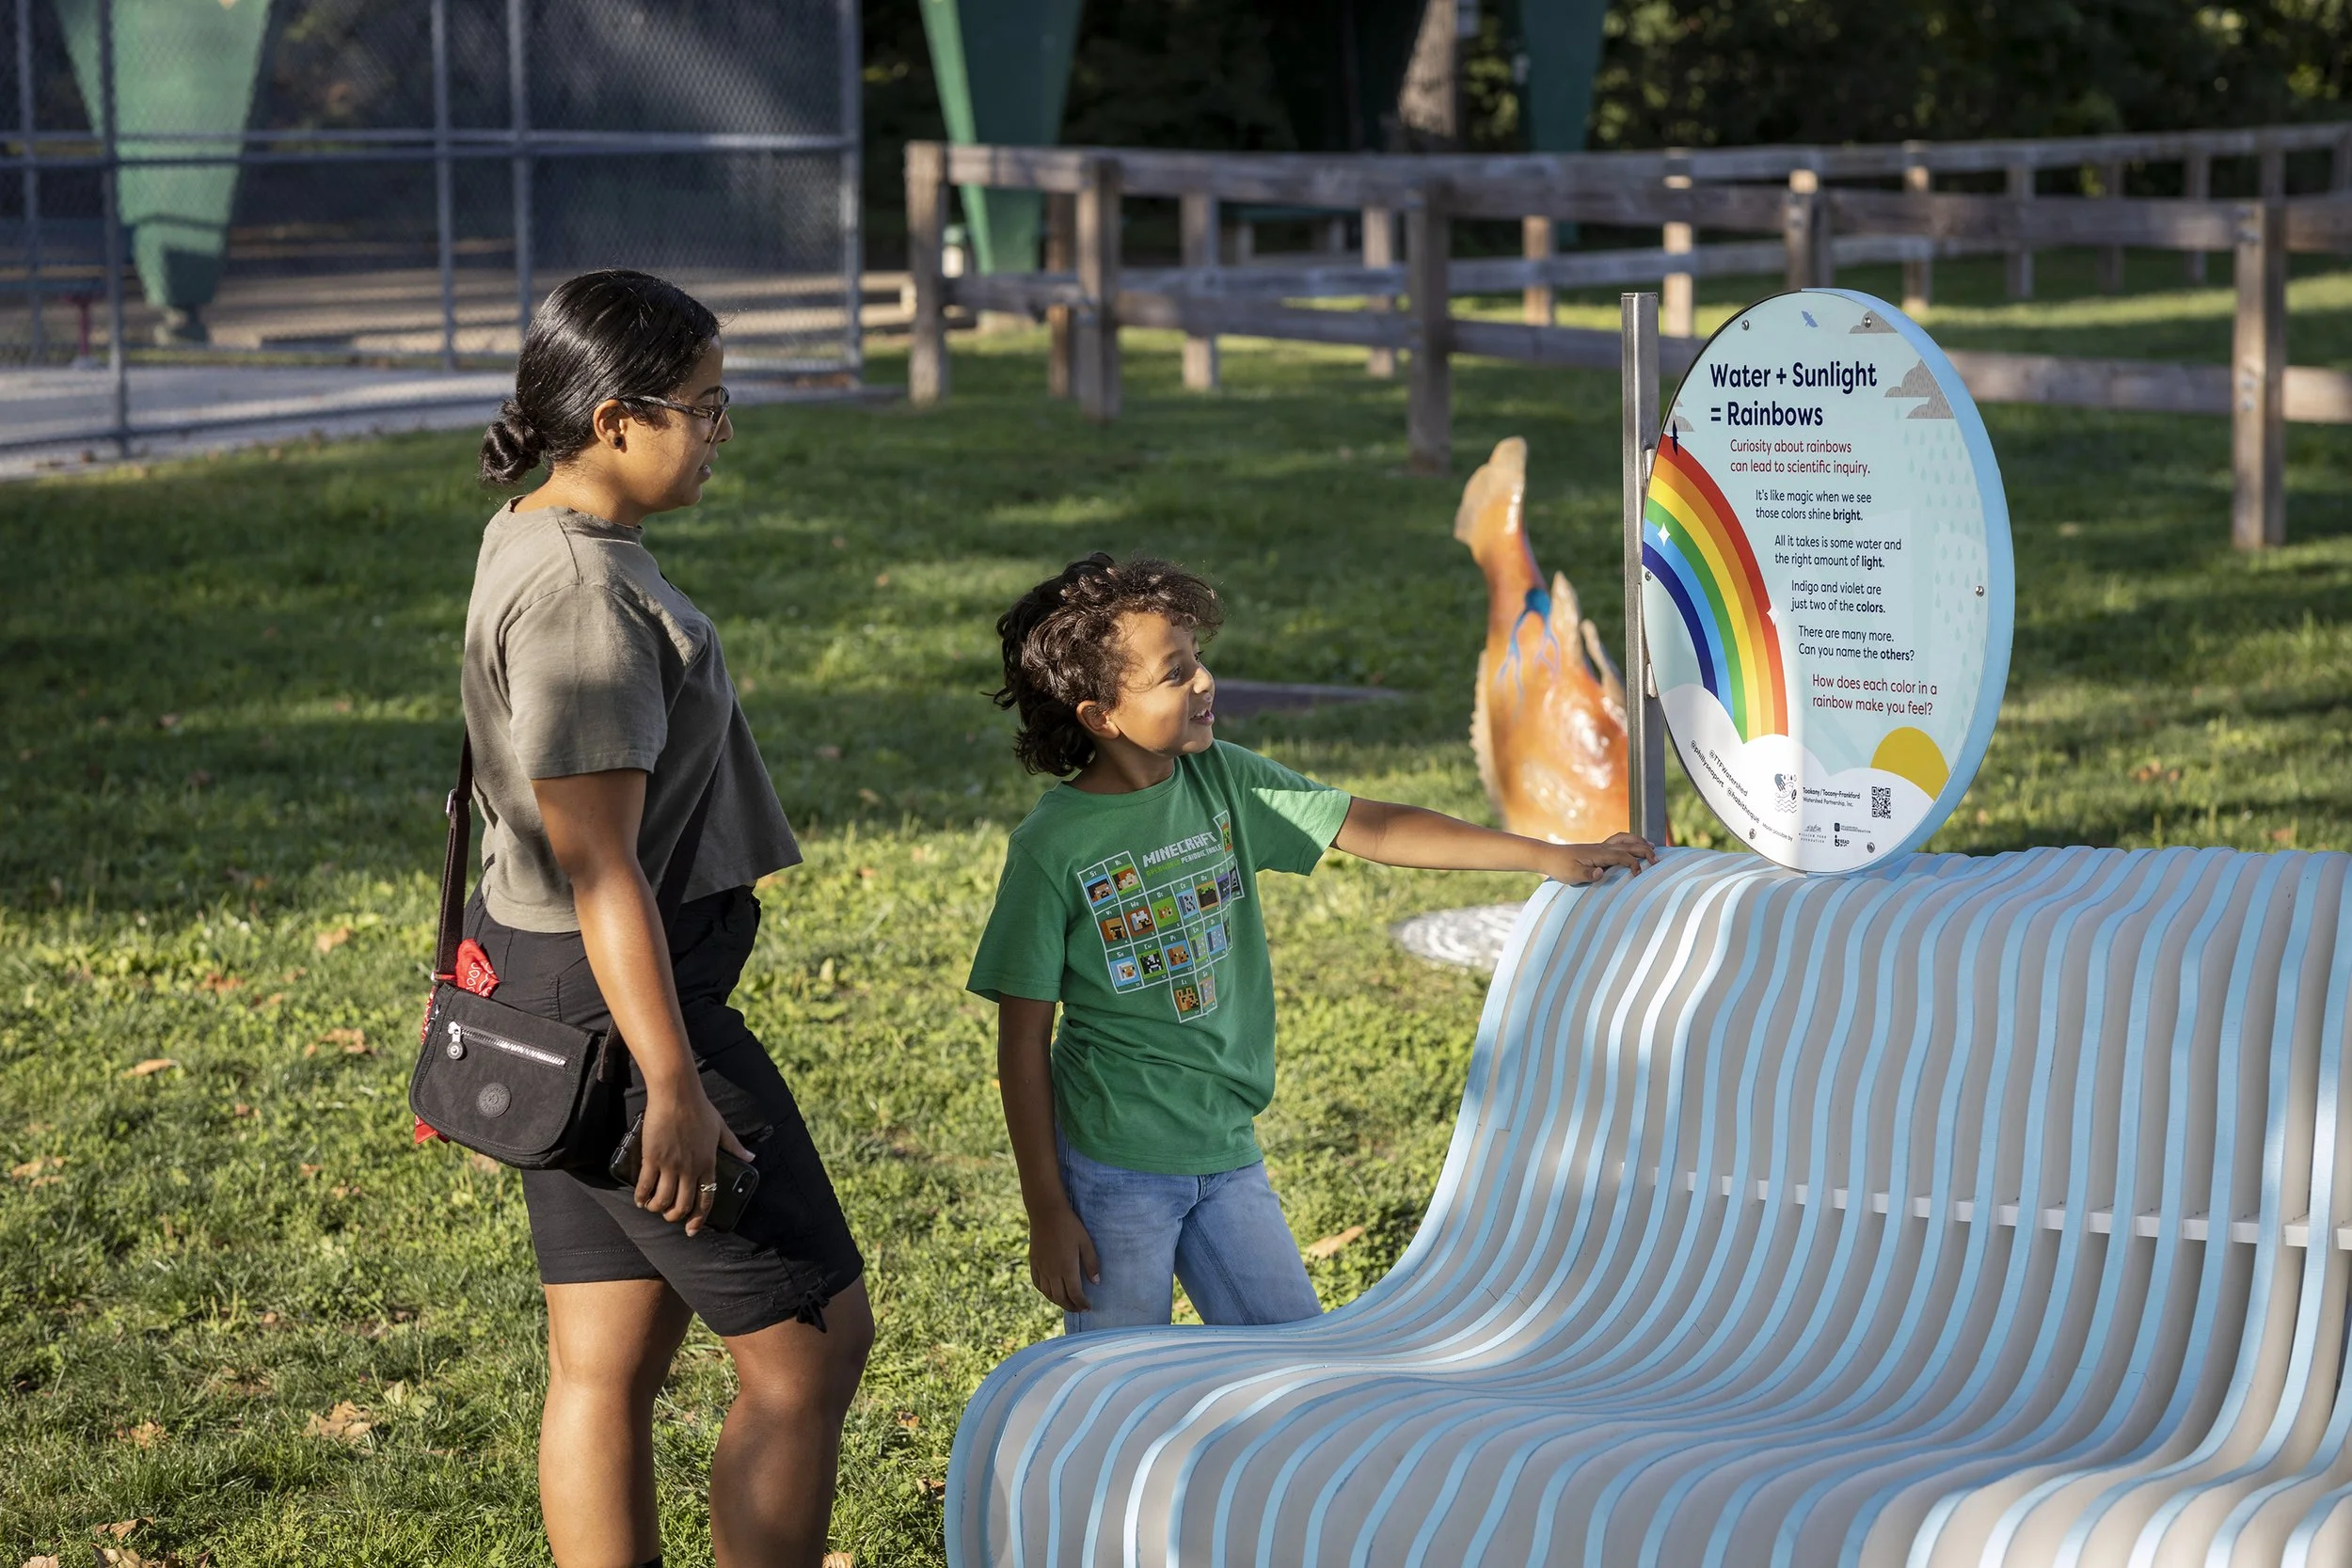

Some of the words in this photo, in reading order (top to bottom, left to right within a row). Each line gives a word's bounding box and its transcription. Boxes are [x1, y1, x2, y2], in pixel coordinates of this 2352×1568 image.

[1709, 363, 1772, 388] Water
[1776, 368, 1787, 385] +
[1792, 361, 1877, 394] Sunlight
[1710, 407, 1722, 421] =
[1727, 401, 1823, 426] Rainbows
[1730, 439, 1772, 455] Curiosity
[1774, 439, 1804, 452] about
[1806, 440, 1852, 453] rainbows
[1730, 462, 1748, 472] can
[1751, 460, 1772, 472] lead
[1774, 461, 1785, 473] to
[1788, 460, 1831, 473] scientific
[1834, 460, 1871, 477] inquiry.
[1770, 490, 1785, 501] like
[1787, 490, 1814, 505] magic
[1816, 491, 1839, 502] when
[1841, 494, 1854, 503] we
[1856, 494, 1872, 503] see
[1756, 507, 1779, 519] those
[1781, 508, 1806, 519] colors
[1808, 508, 1831, 520] shine
[1833, 509, 1864, 524] bright.
[1774, 535, 1786, 546] All
[1788, 535, 1794, 547] it
[1796, 536, 1820, 547] takes
[1821, 536, 1829, 548] is
[1830, 539, 1853, 548] some
[1855, 540, 1882, 550] water
[1883, 539, 1902, 550] and
[1774, 552, 1789, 564] the
[1791, 553, 1812, 568] right
[1814, 556, 1849, 566] amount
[1850, 555, 1861, 567] of
[1861, 556, 1885, 571] light.
[1791, 579, 1819, 595] Indigo
[1820, 581, 1838, 594] and
[1840, 581, 1866, 594] violet
[1867, 585, 1882, 595] are
[1790, 597, 1807, 612] just
[1809, 598, 1826, 610] two
[1828, 599, 1838, 611] of
[1839, 599, 1854, 611] the
[1856, 600, 1886, 613] colors.
[1798, 626, 1823, 638] There
[1825, 628, 1840, 639] are
[1842, 629, 1867, 643] many
[1868, 631, 1895, 642] more.
[1798, 642, 1816, 655] Can
[1818, 646, 1834, 658] you
[1836, 647, 1861, 658] name
[1863, 647, 1879, 659] the
[1881, 648, 1915, 661] others?
[1812, 673, 1835, 688] How
[1836, 675, 1861, 689] does
[1863, 678, 1888, 691] each
[1890, 679, 1916, 693] color
[1918, 680, 1928, 695] in
[1930, 685, 1938, 695] a
[1812, 694, 1853, 709] rainbow
[1855, 699, 1884, 712] make
[1886, 702, 1905, 716] you
[1908, 700, 1933, 716] feel?
[1691, 739, 1724, 788] @phillyseaport
[1726, 787, 1760, 824] @habitheque
[1708, 749, 1748, 797] @TTFWatershed
[1142, 832, 1217, 867] MINECRAFT
